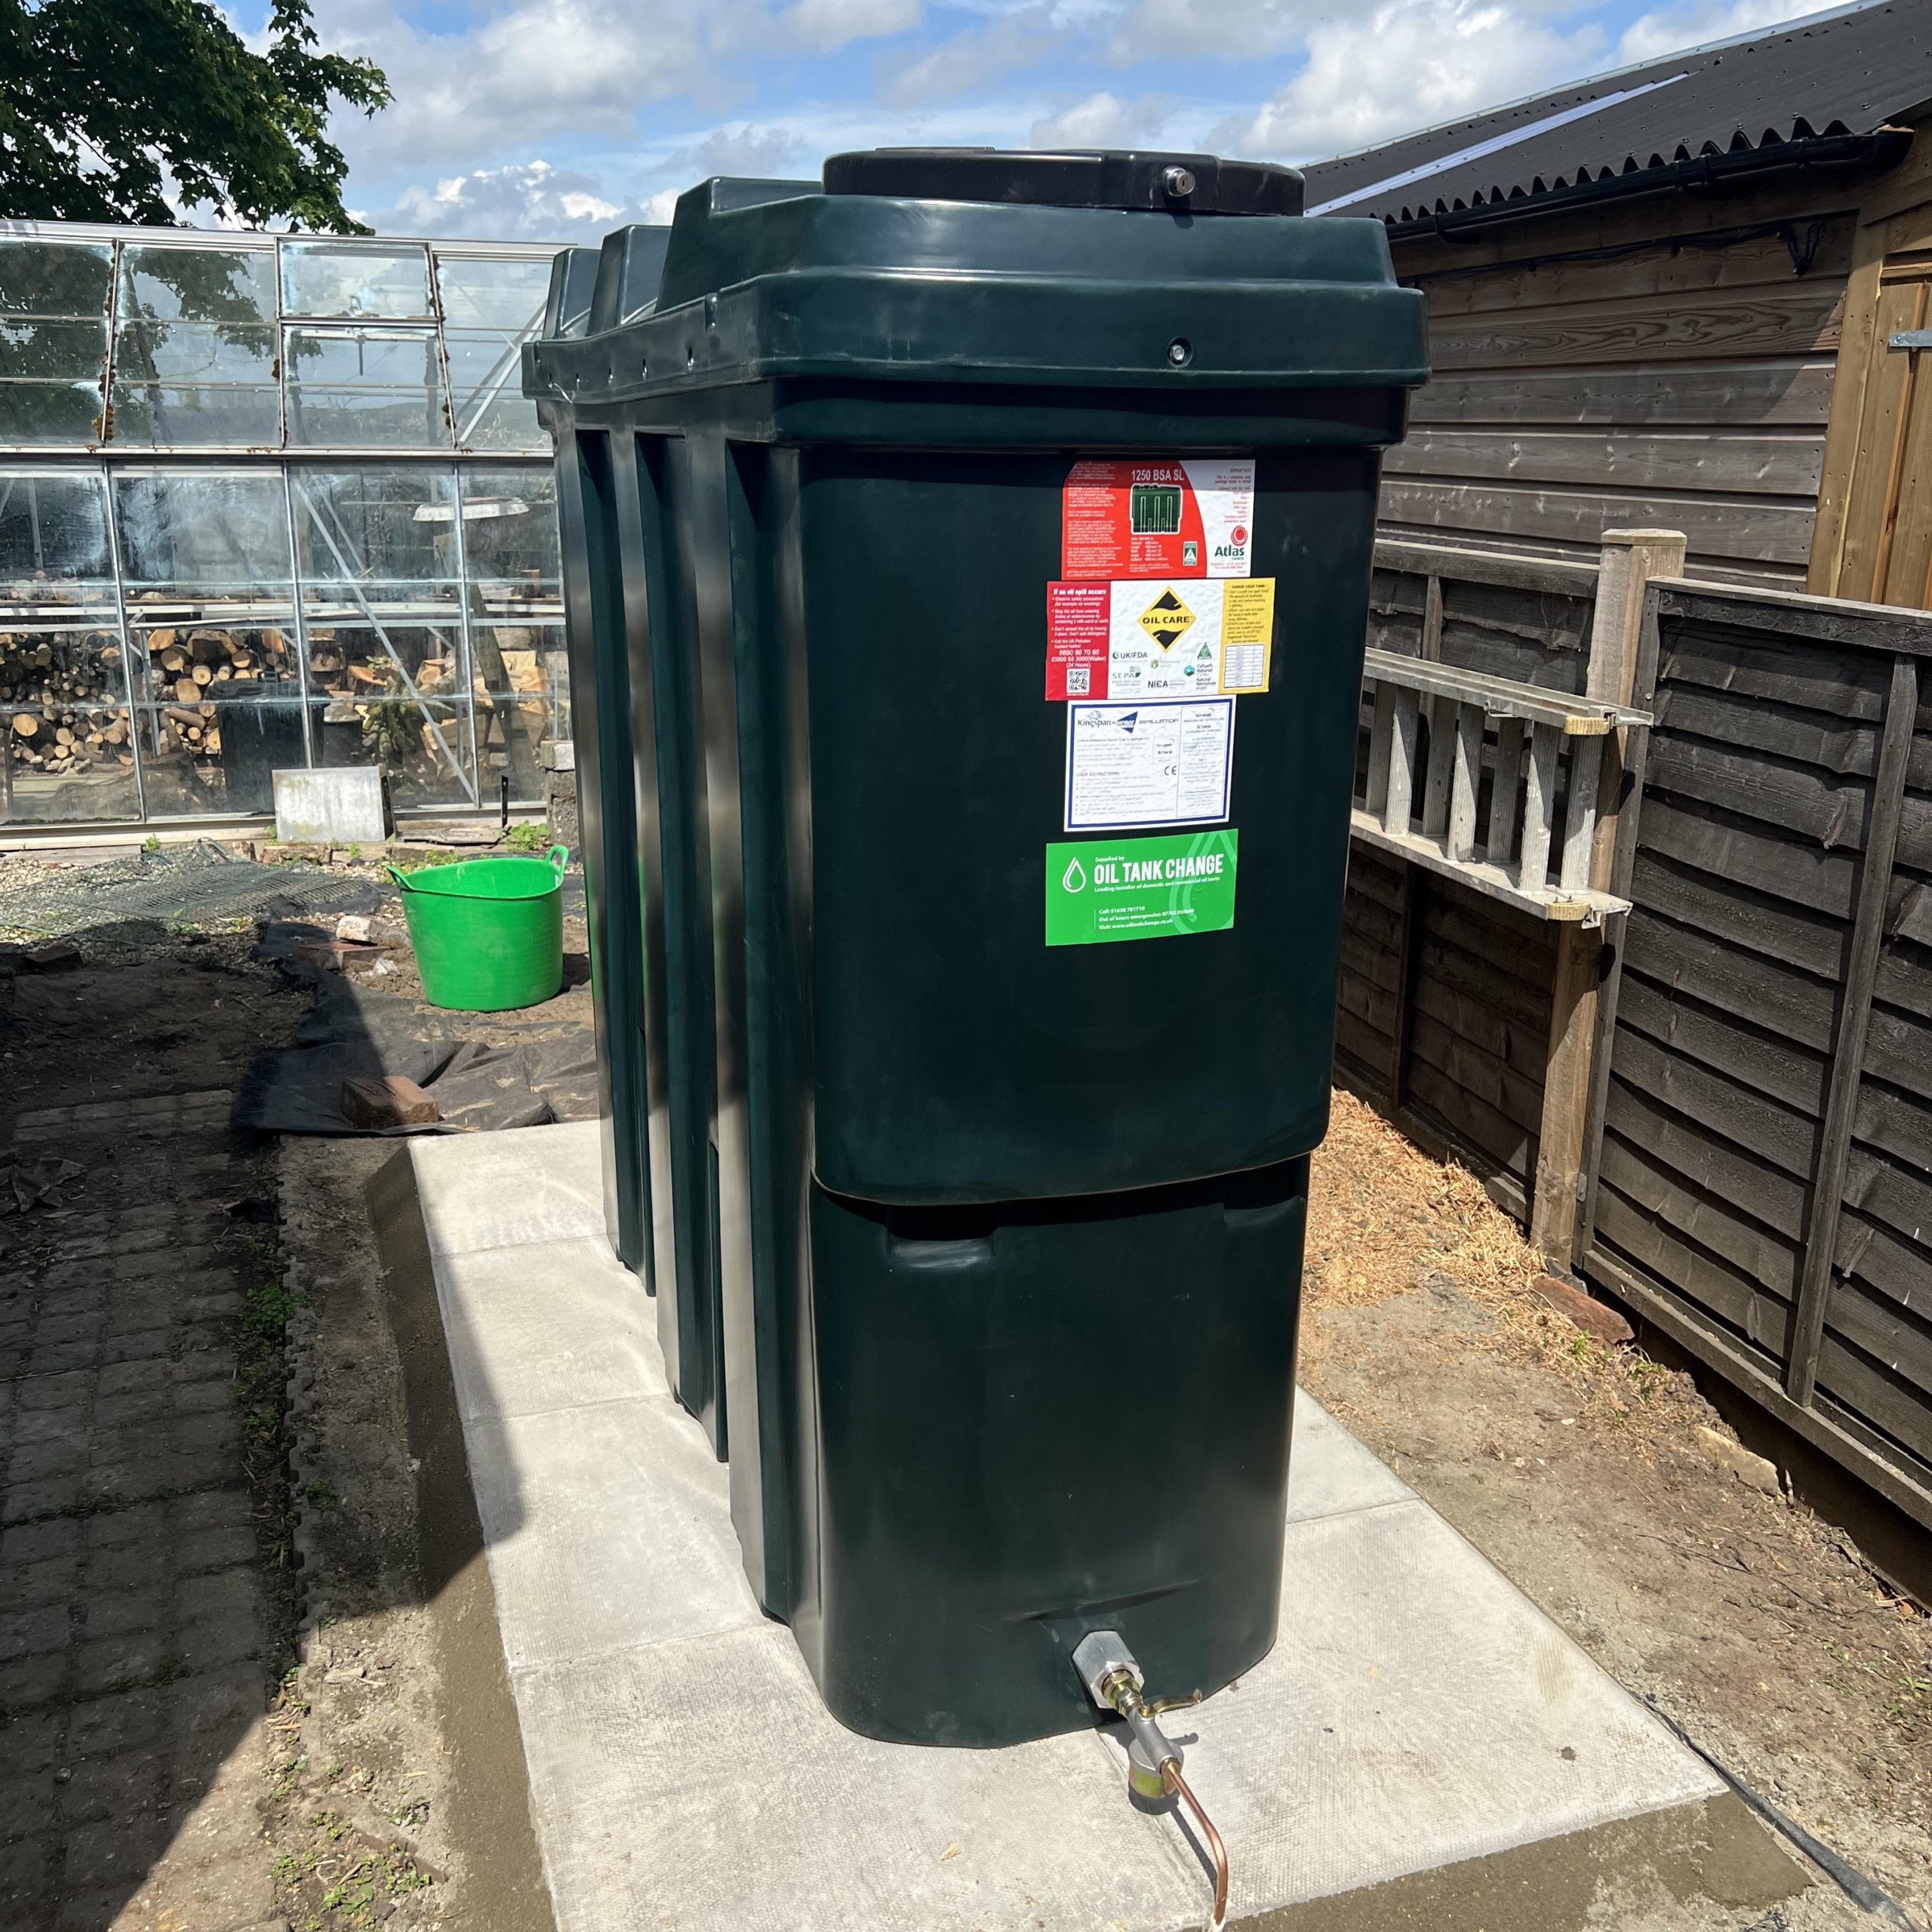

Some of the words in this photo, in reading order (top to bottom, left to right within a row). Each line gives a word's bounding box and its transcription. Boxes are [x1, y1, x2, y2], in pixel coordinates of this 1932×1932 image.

[1131, 469, 1151, 481] 1250
[1153, 469, 1171, 481] BSA
[1173, 469, 1183, 481] SL
[1214, 544, 1244, 556] Atlas
[1147, 680, 1168, 688] NIEA
[1078, 718, 1111, 728] Kingspan
[1094, 863, 1119, 884] OIL
[1122, 860, 1163, 882] TANK
[1165, 854, 1223, 878] CHANGE
